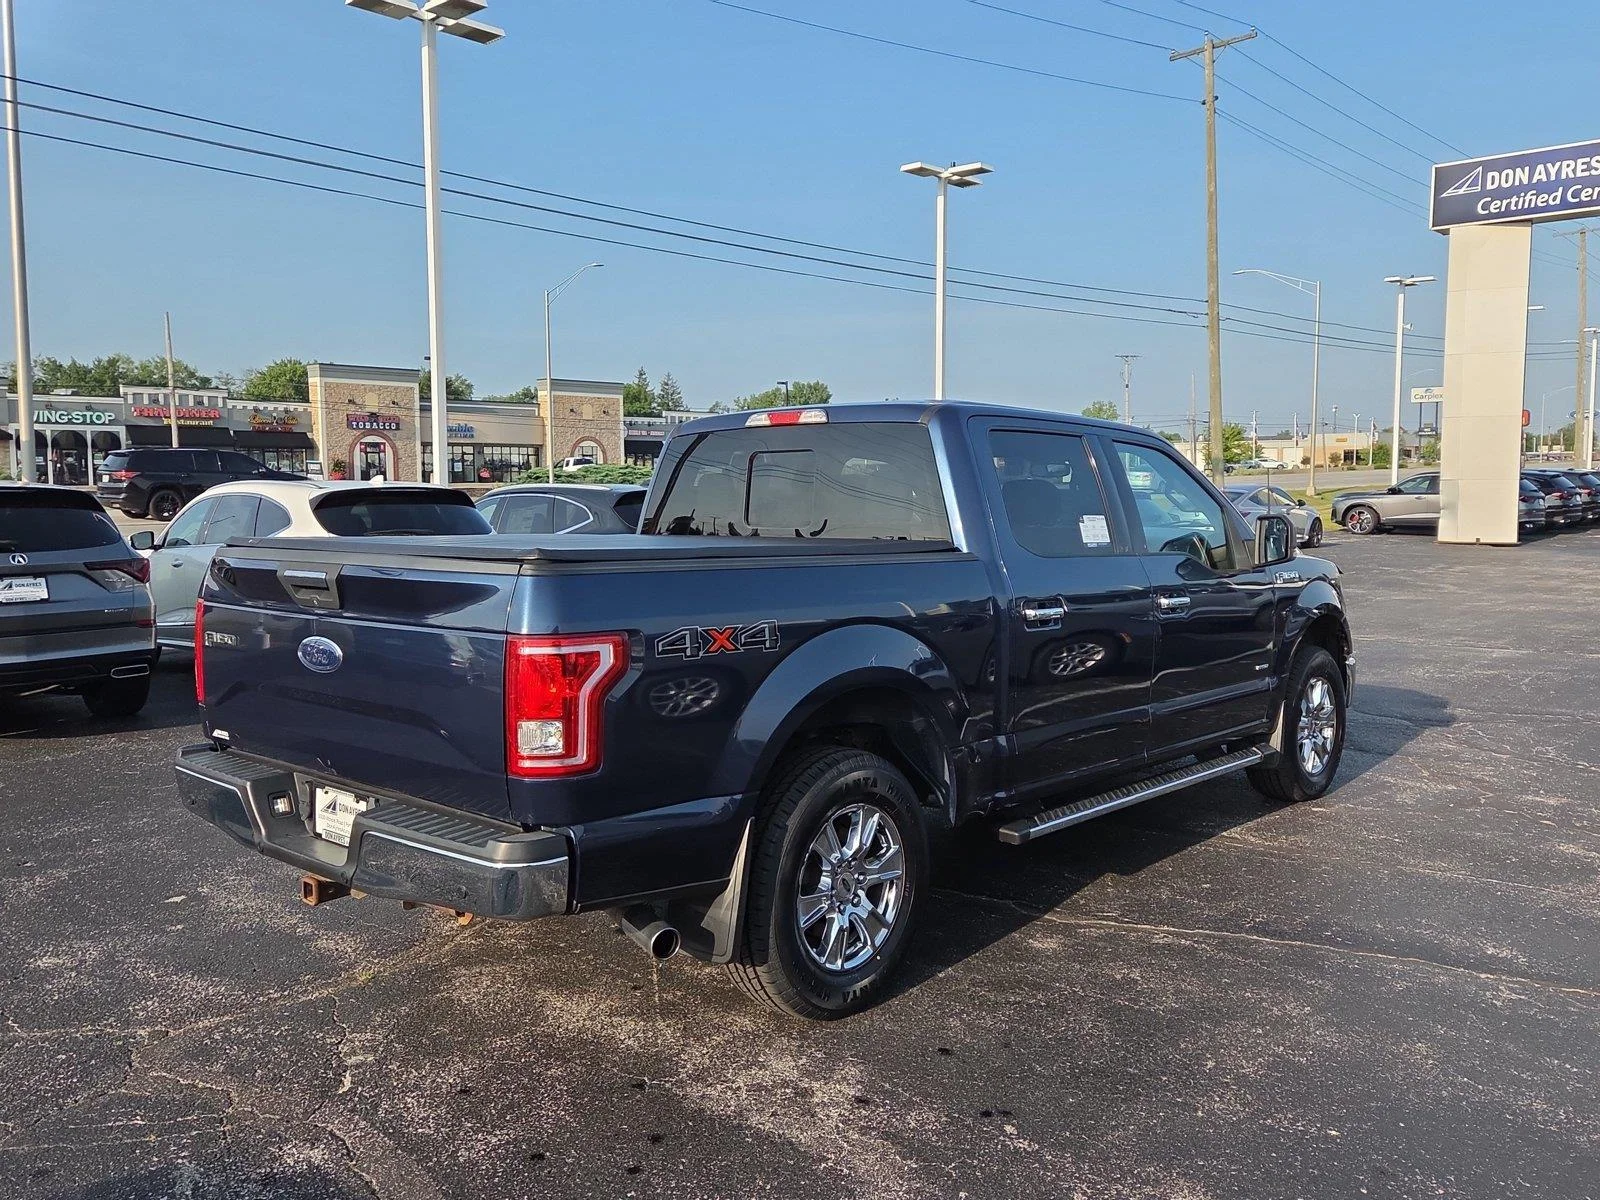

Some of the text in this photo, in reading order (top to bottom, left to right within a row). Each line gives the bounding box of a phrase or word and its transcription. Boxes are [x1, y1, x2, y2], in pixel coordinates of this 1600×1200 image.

[1486, 155, 1600, 190] DON AYRES
[1477, 187, 1563, 215] Certified
[175, 408, 220, 418] DINER
[351, 421, 397, 430] TOBACCO
[339, 802, 349, 813] DON
